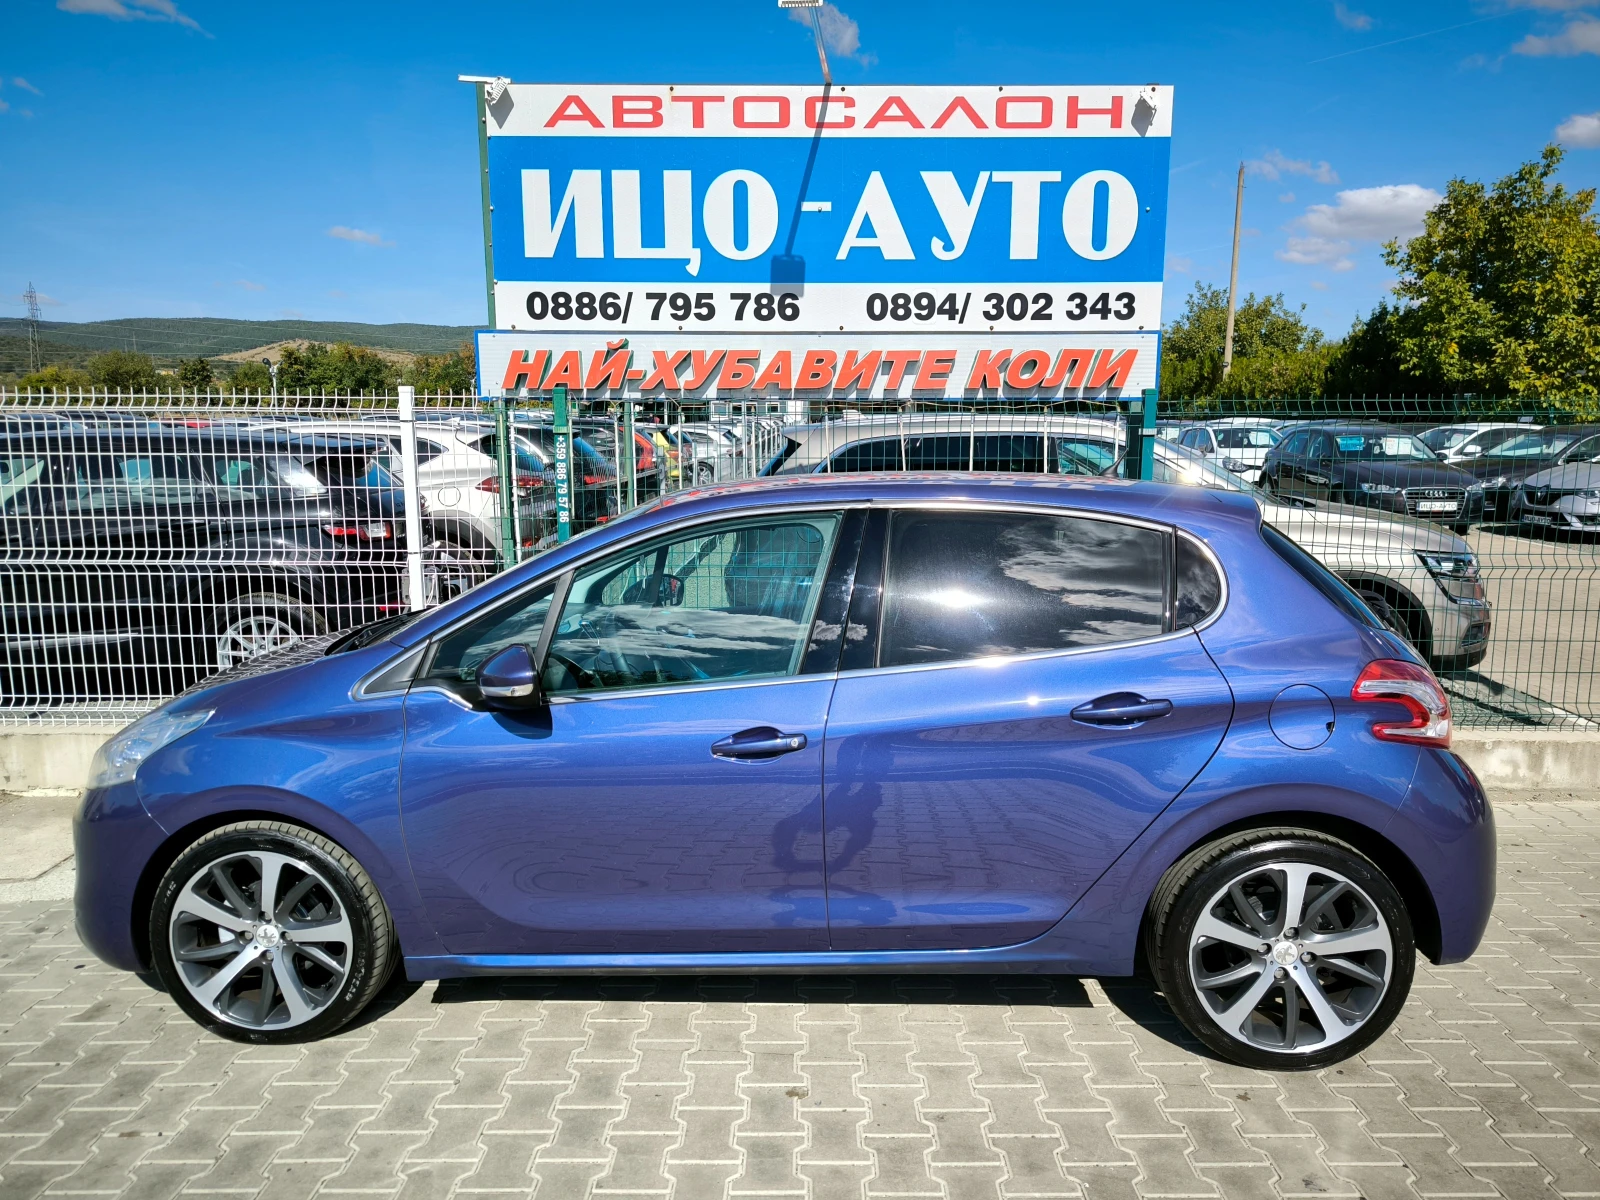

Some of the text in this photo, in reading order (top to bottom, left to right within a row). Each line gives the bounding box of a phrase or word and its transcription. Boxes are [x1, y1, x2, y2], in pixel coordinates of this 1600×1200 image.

[543, 95, 1124, 129] АВТОСАЛОН
[526, 291, 800, 324] 0886/ 795 786
[866, 292, 1136, 324] 0894/ 302 343
[501, 338, 1139, 390] НАЙ-ХУБАВИТЕ КОЛИ
[556, 435, 569, 523] +359 886 79 57 86
